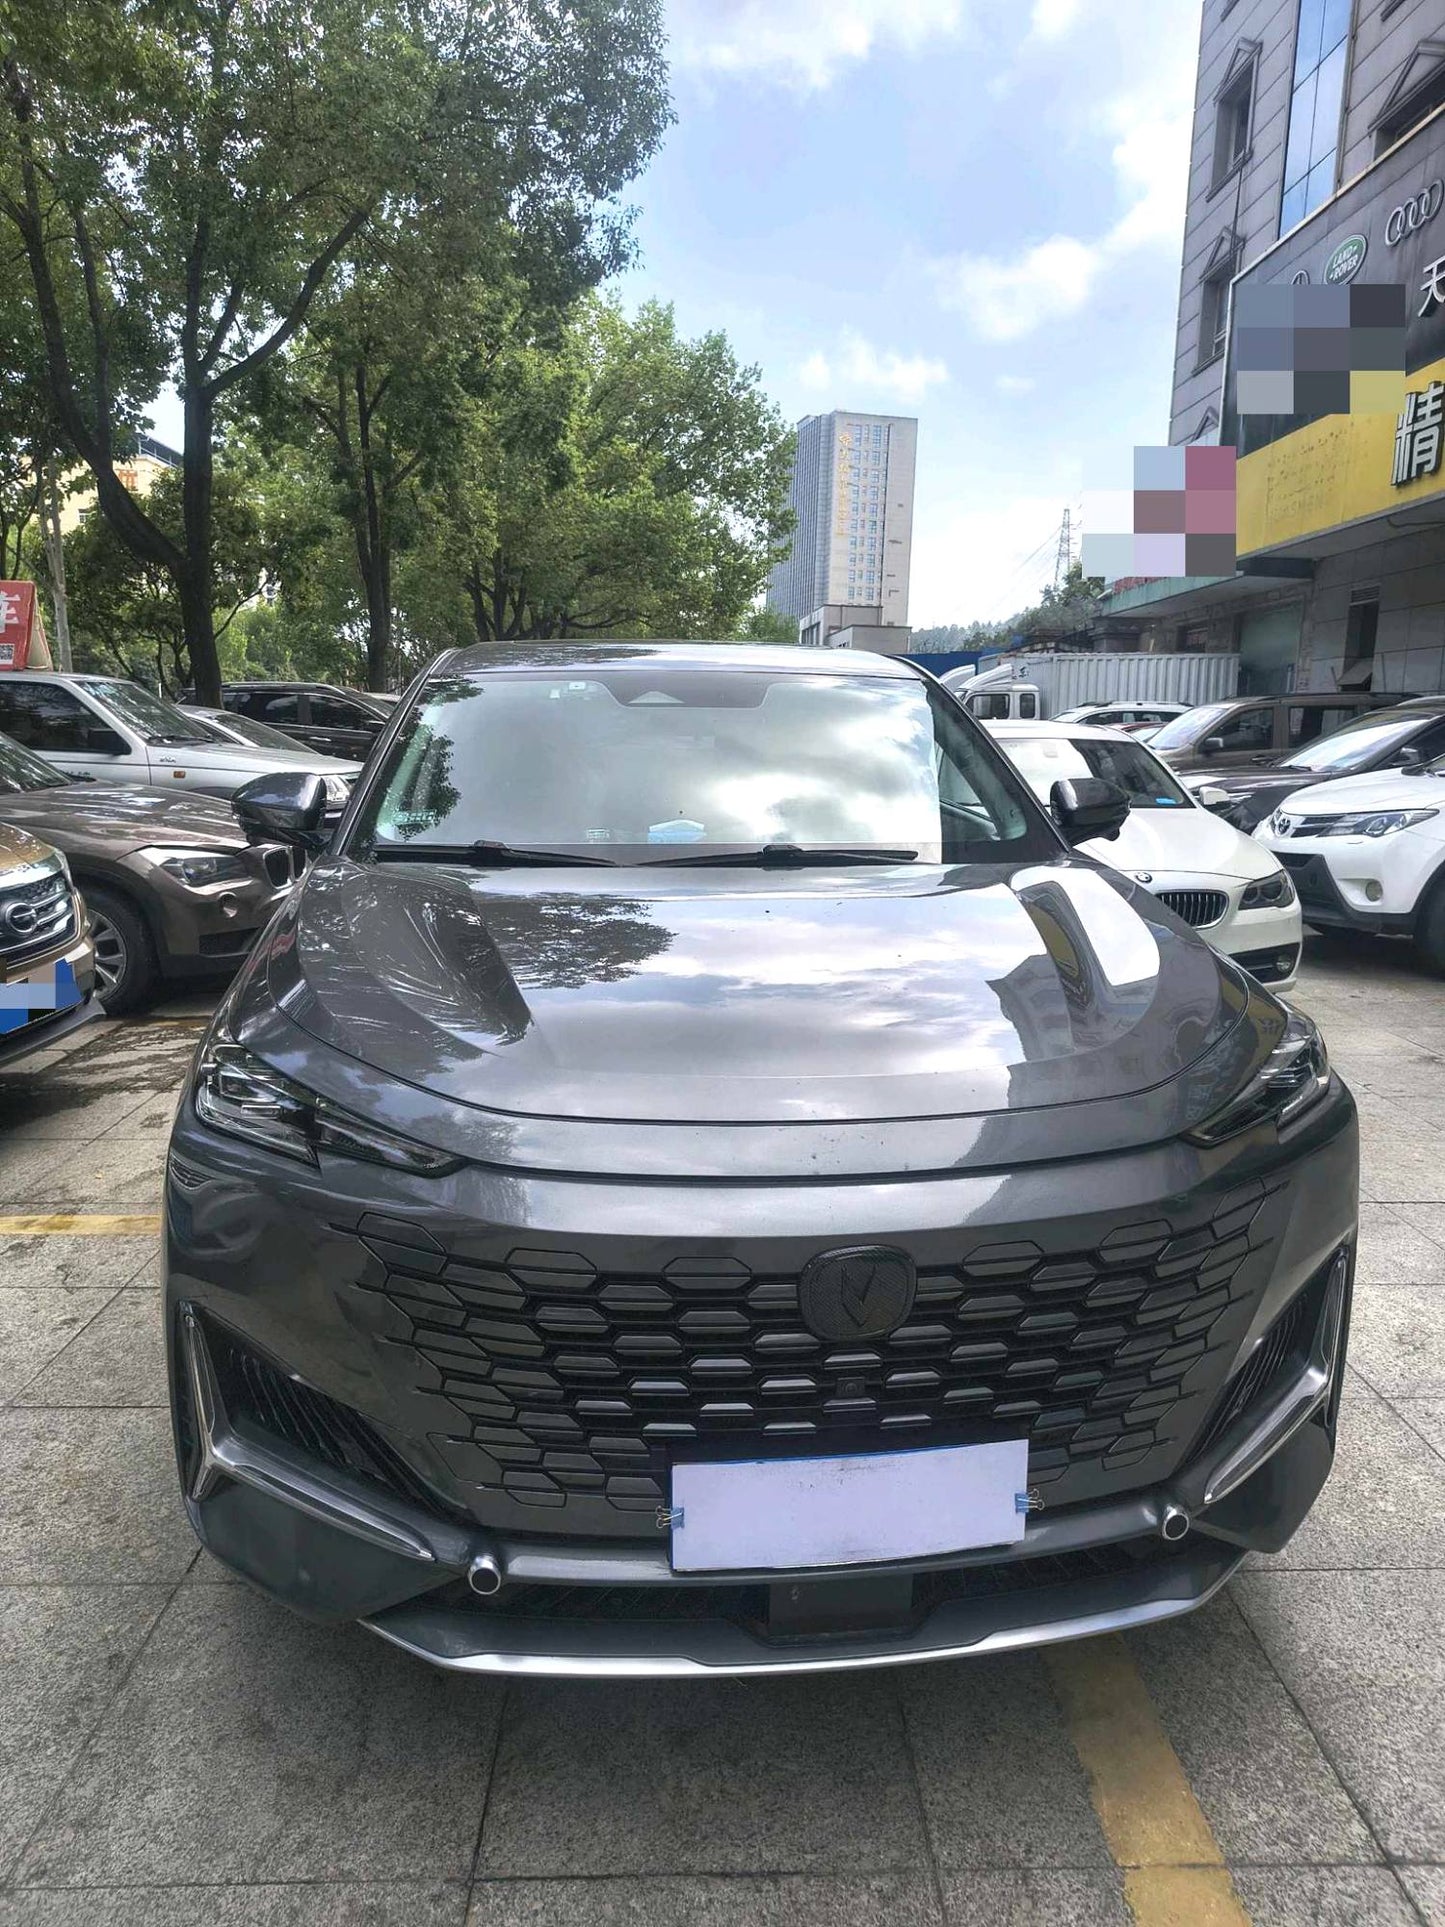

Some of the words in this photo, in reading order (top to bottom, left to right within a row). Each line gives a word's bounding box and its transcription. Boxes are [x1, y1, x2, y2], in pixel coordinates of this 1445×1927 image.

[1332, 246, 1353, 268] LAND
[1334, 254, 1358, 280] ROVER
[1391, 383, 1445, 486] 精
